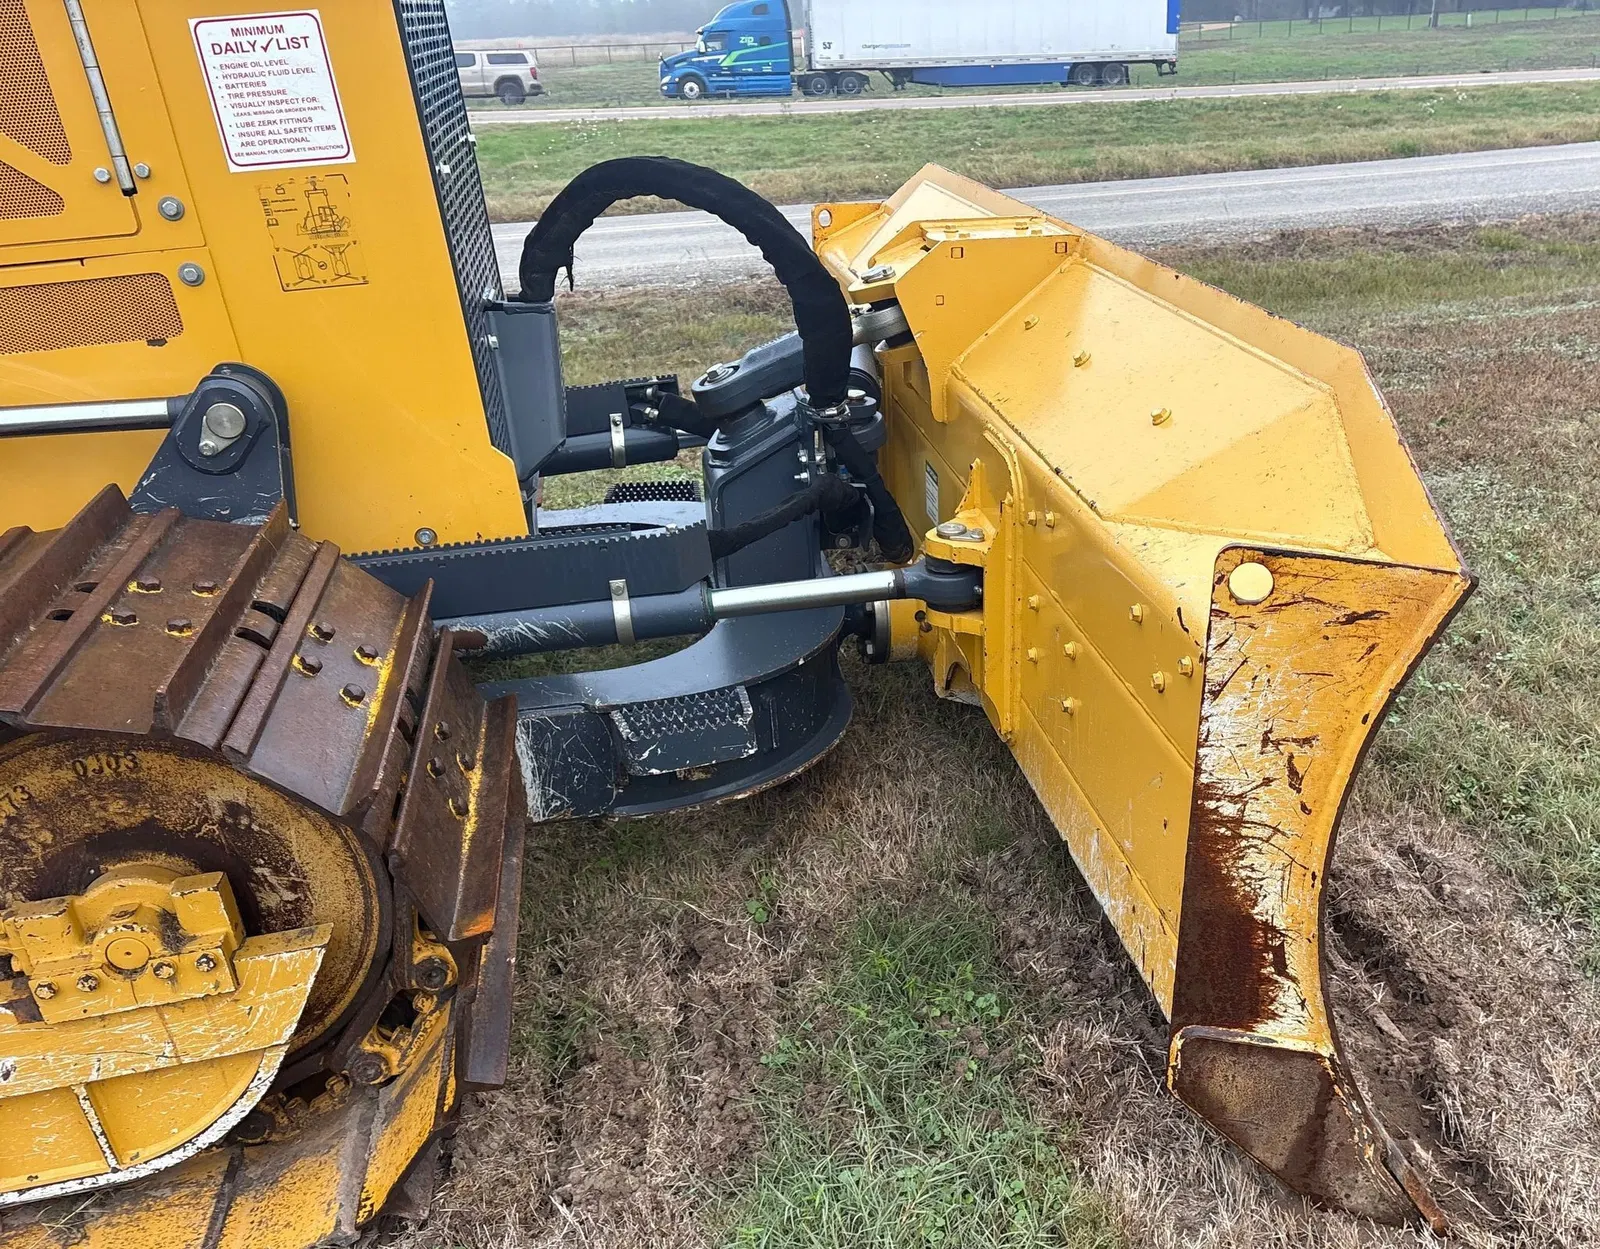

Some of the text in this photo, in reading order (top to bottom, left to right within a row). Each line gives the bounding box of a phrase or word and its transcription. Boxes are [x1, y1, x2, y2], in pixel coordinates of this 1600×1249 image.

[230, 24, 285, 37] MINIMUM
[211, 36, 310, 56] DAILY LIST
[219, 62, 249, 71] ENGINE
[264, 59, 289, 67] LEVEL
[222, 67, 316, 80] HYDRAULIC FLUID LEVEL
[225, 80, 267, 90] BATTERIES
[227, 89, 288, 100] TIRE PRESSURE
[230, 101, 266, 109] VISUALLY
[267, 98, 300, 106] INSPECT
[235, 116, 313, 128] LUBE ZERK FITTINGS
[237, 124, 337, 138] INSURE ALL SAFETY ITEMS
[240, 136, 310, 148] ARE OPERATIONAL
